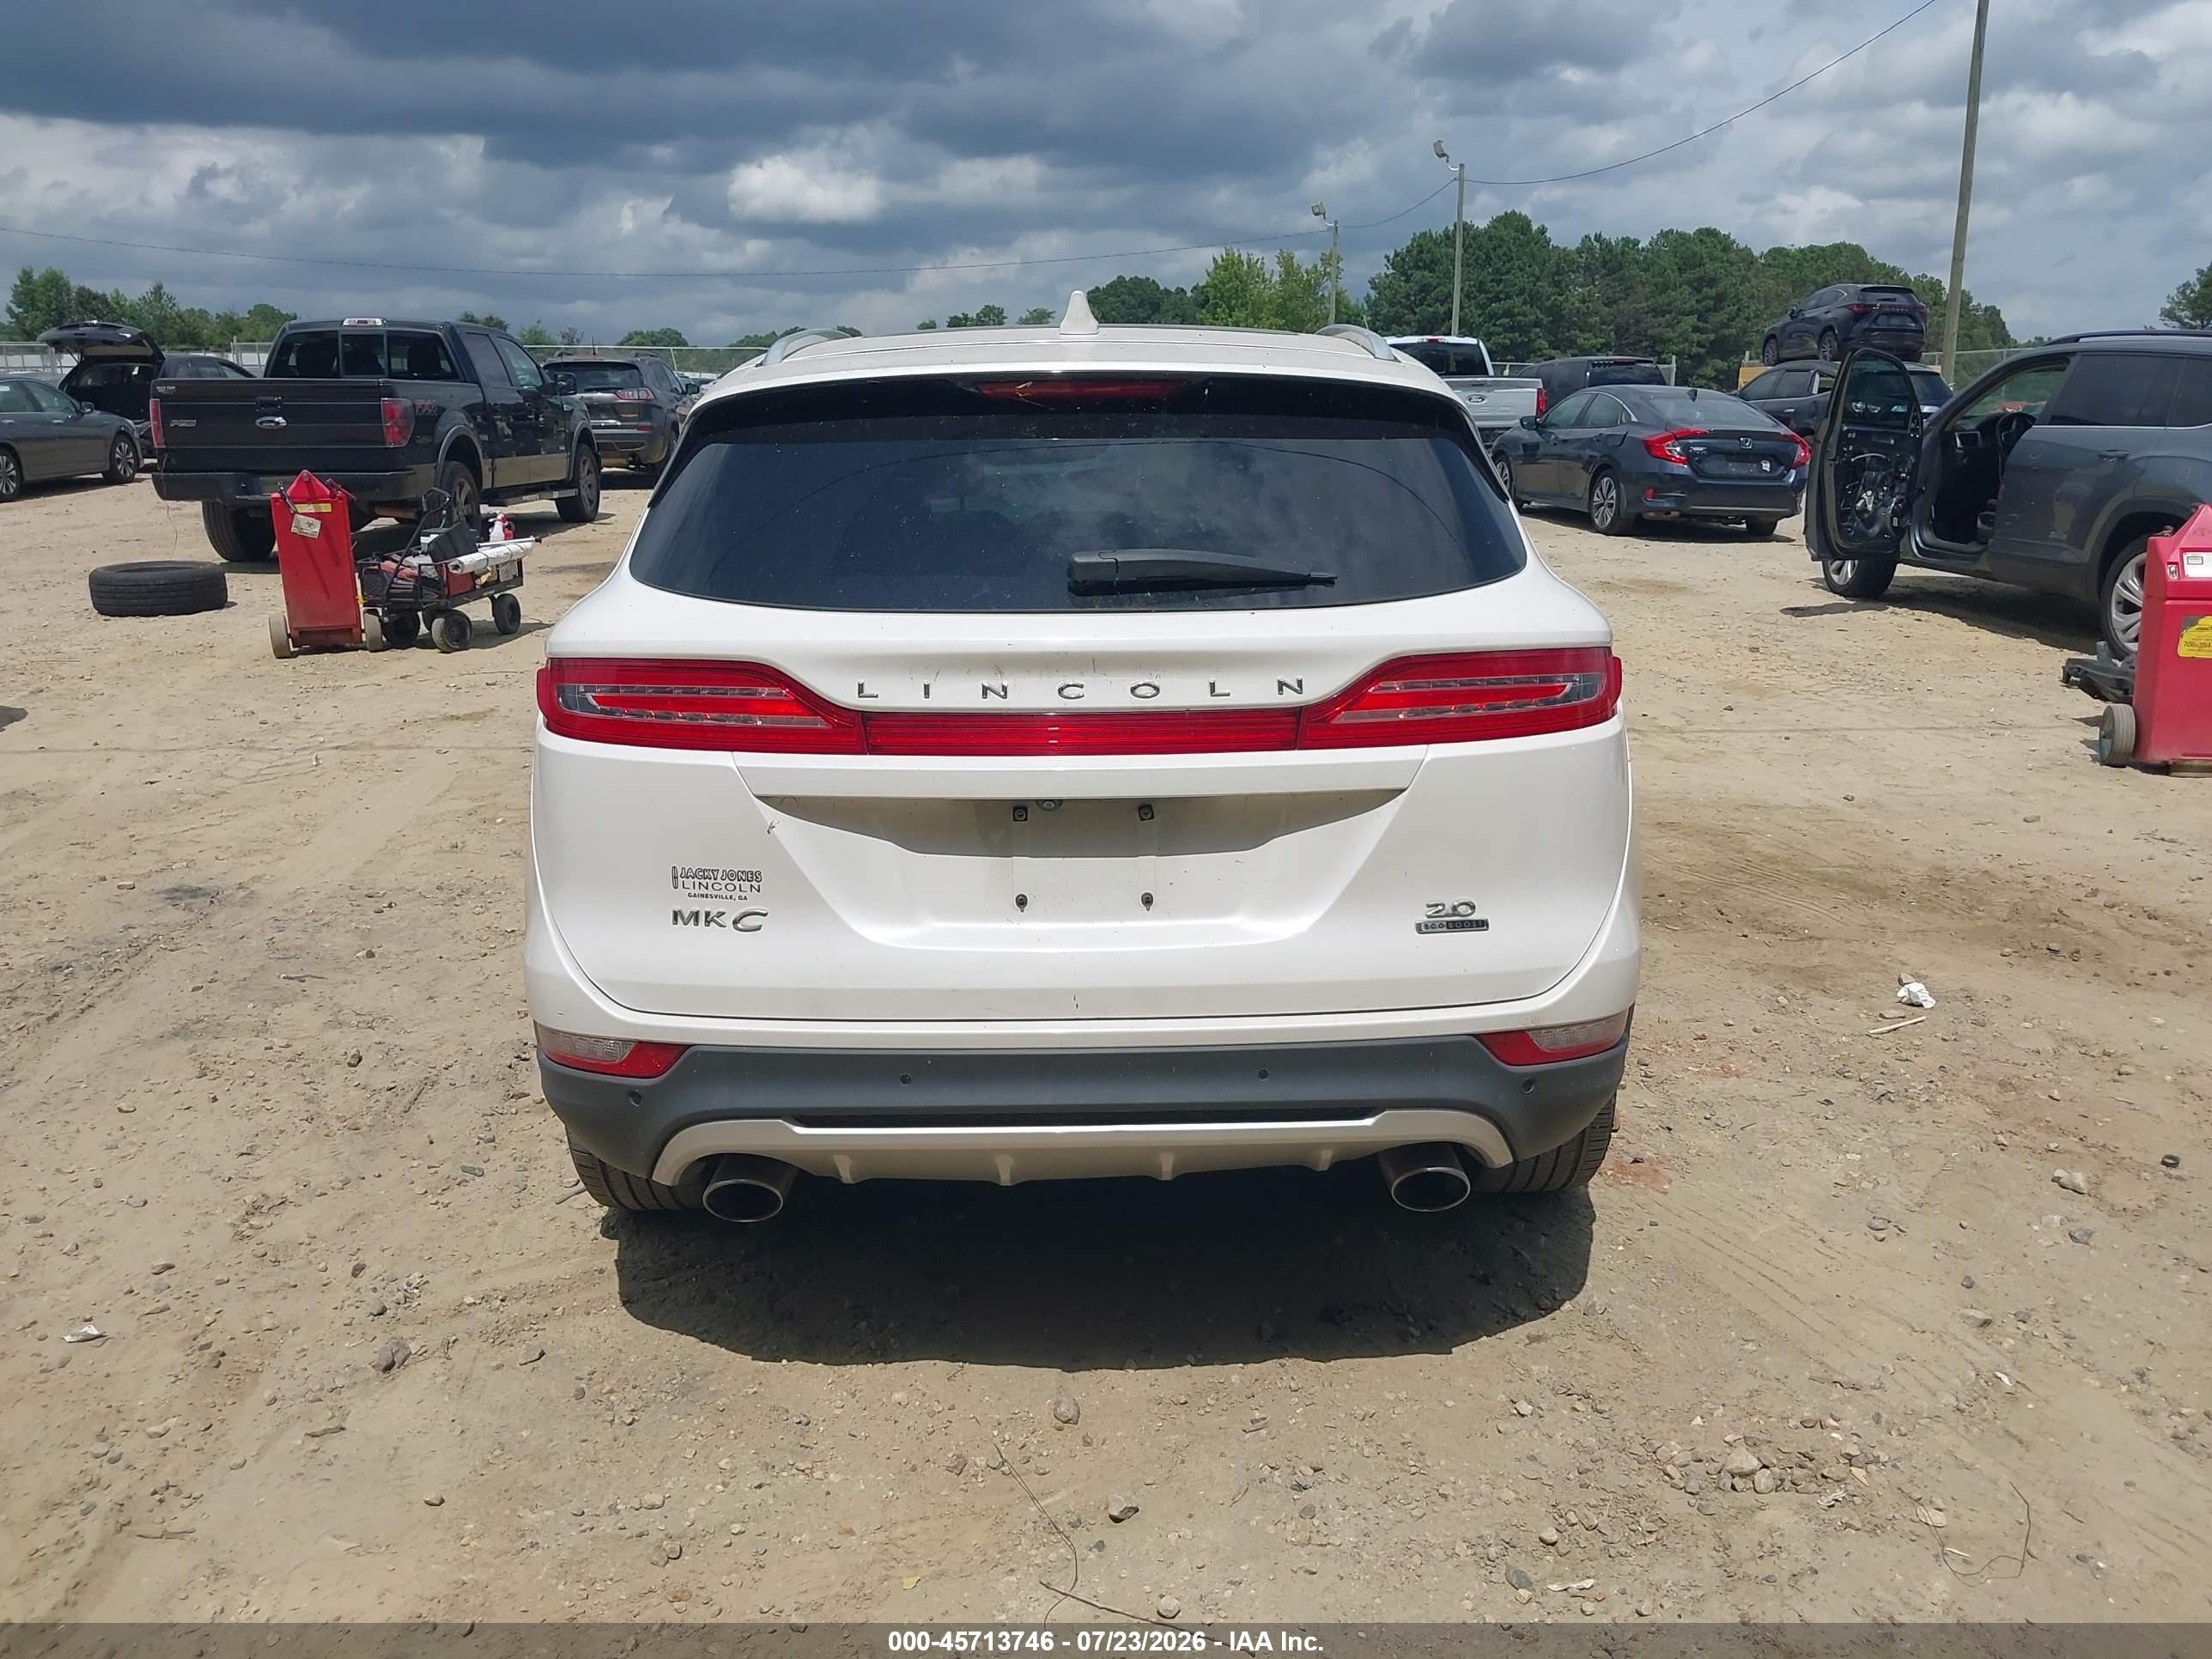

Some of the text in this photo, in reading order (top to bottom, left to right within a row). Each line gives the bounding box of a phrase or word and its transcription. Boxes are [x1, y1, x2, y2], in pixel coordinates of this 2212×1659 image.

[857, 677, 1304, 699] LINCOLN
[679, 867, 763, 883] JACKY JONES
[682, 881, 761, 893] LINCOLN
[688, 892, 736, 902] GAINESVILLE,
[672, 908, 769, 933] MKC
